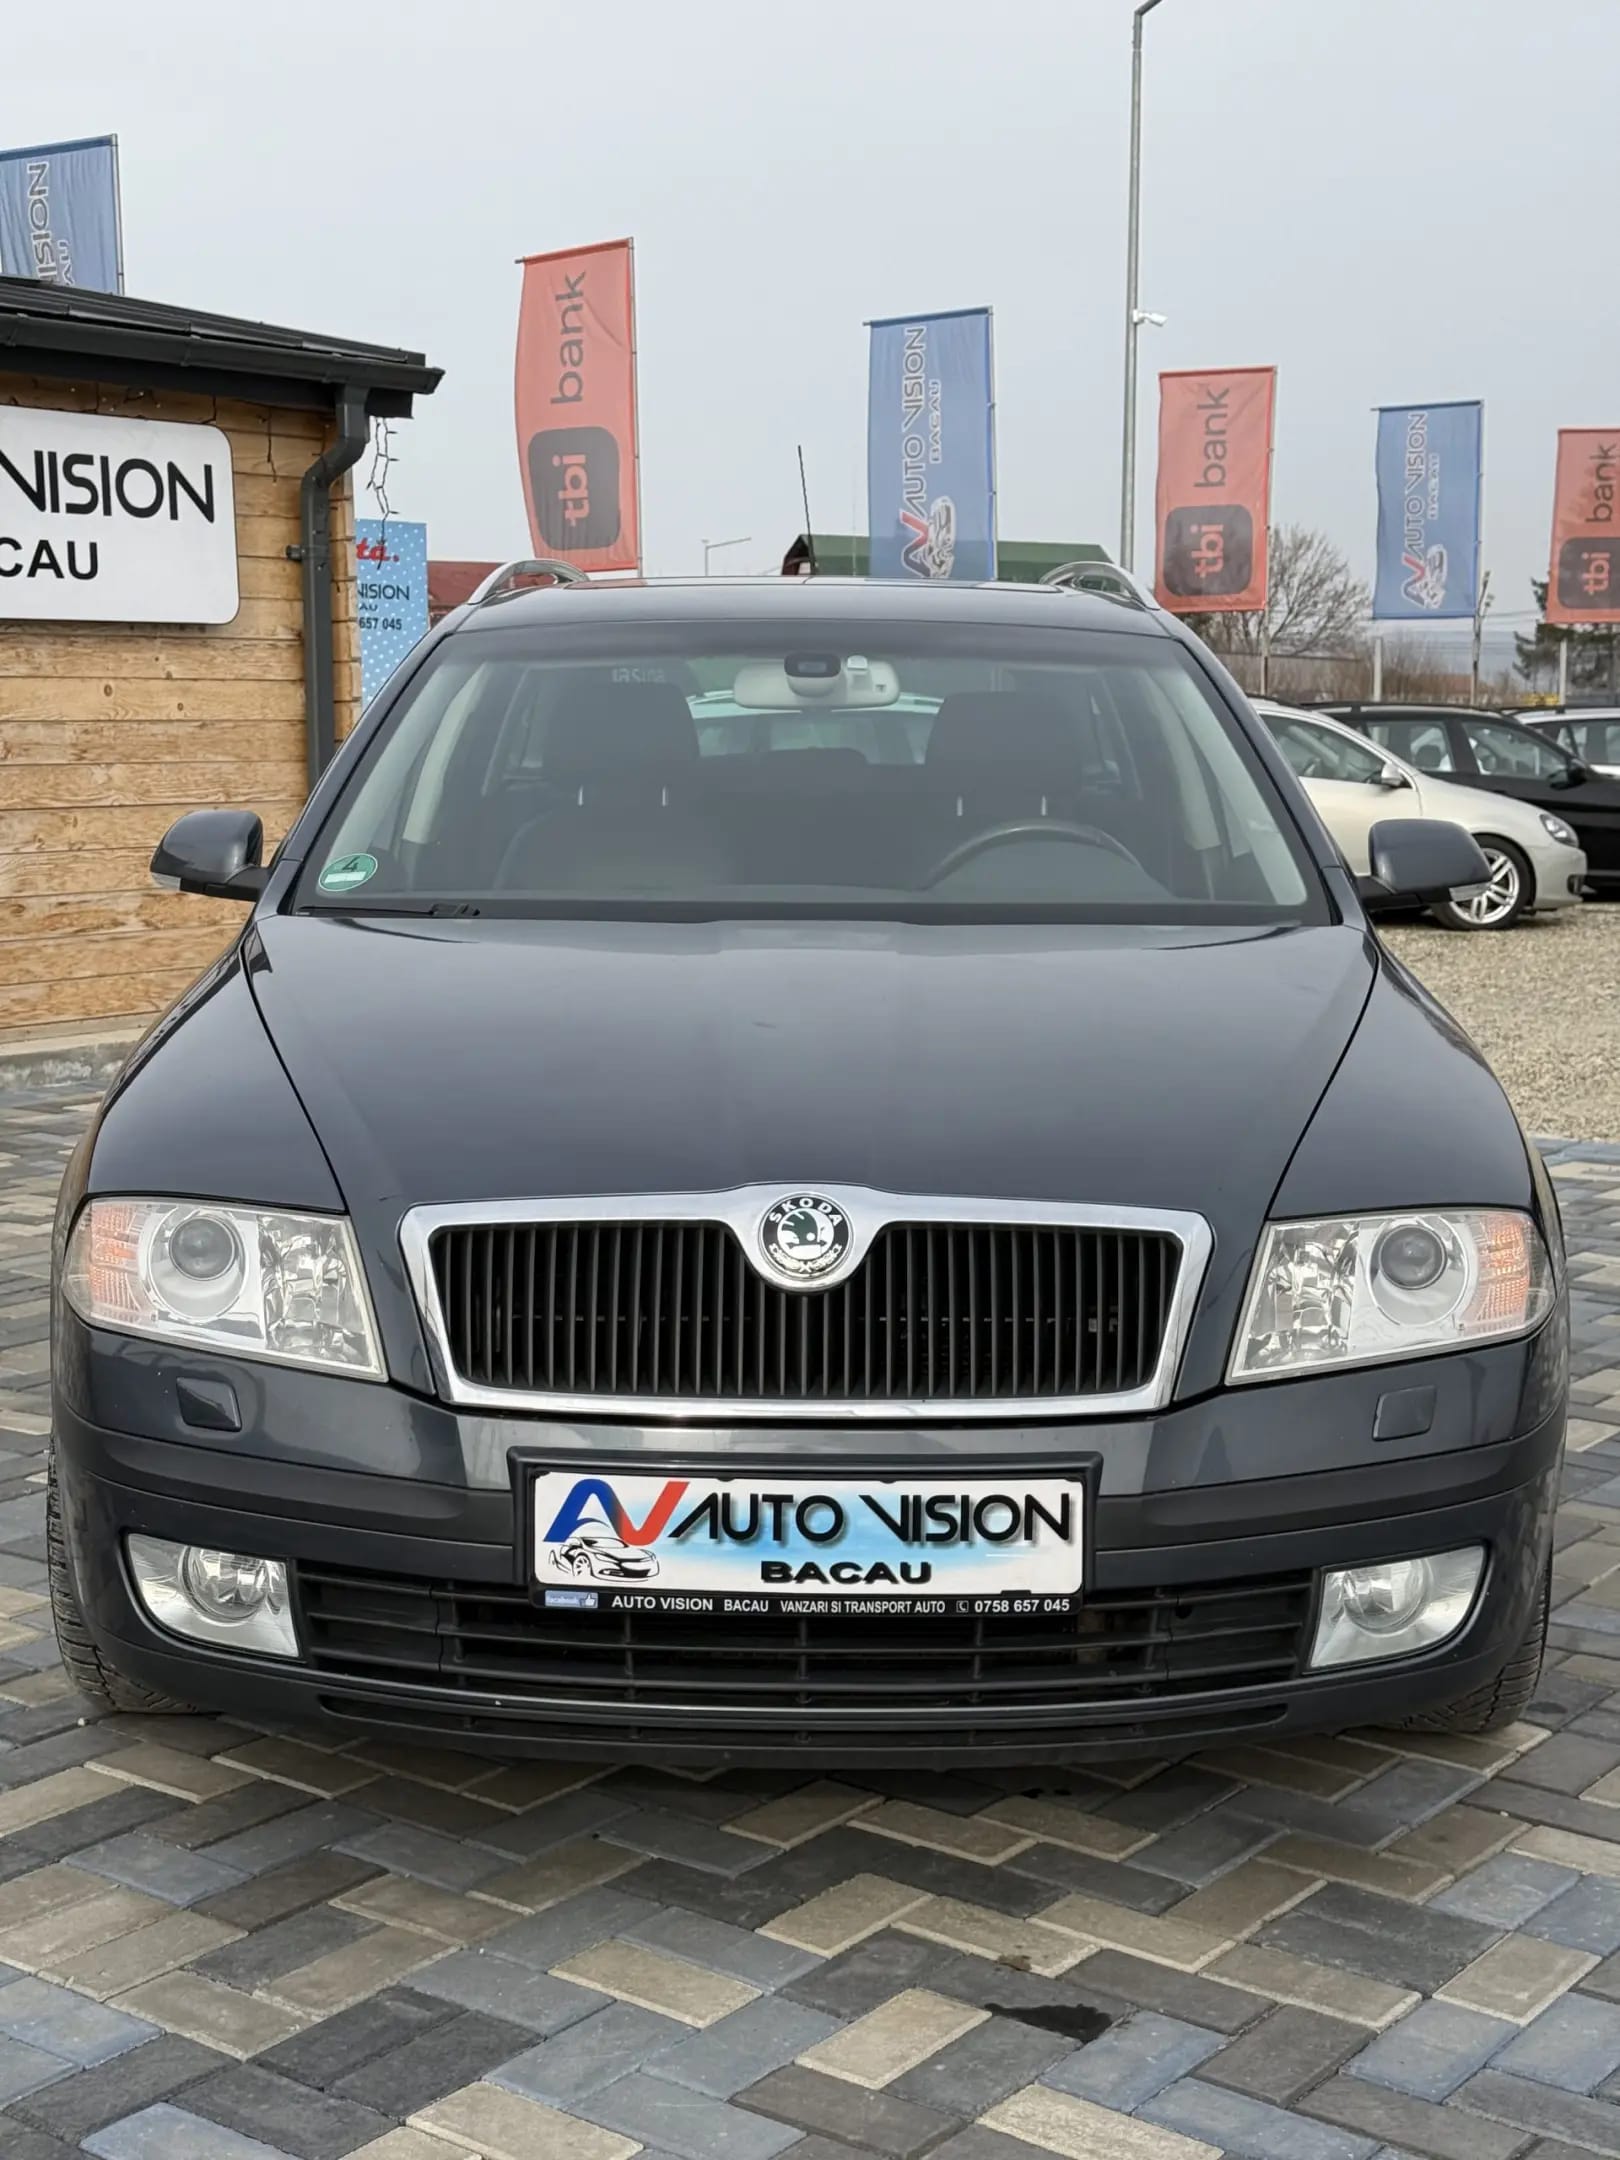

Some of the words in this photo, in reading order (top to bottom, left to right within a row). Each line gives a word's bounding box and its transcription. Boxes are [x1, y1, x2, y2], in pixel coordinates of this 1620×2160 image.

[550, 270, 587, 405] bank
[903, 326, 927, 432] VISION
[1194, 386, 1231, 488] bank
[1404, 411, 1428, 495] VISION
[0, 449, 215, 524] VISION
[552, 453, 590, 528] tbi
[903, 435, 926, 520] AUTO
[1585, 443, 1617, 523] bank
[0, 537, 98, 580] CAU
[1189, 523, 1224, 579] tbi
[1404, 496, 1426, 562] AUTO
[1581, 552, 1611, 595] tbi
[359, 617, 379, 630] 657
[382, 618, 403, 631] 045
[342, 856, 361, 873] 4
[768, 1197, 843, 1227] SKODA
[668, 1492, 846, 1543] AUTO
[859, 1492, 1071, 1543] VISION
[760, 1560, 932, 1585] BACAU
[611, 1595, 656, 1609] AUTO
[660, 1597, 713, 1611] VISION
[724, 1599, 769, 1612] BACAU
[780, 1600, 828, 1613] VANZARI
[831, 1601, 842, 1613] SI
[844, 1600, 912, 1613] TRANSPORT
[914, 1600, 946, 1613] AUTO
[974, 1600, 1010, 1613] 0758
[1013, 1599, 1039, 1612] 657
[1044, 1598, 1070, 1611] 045
